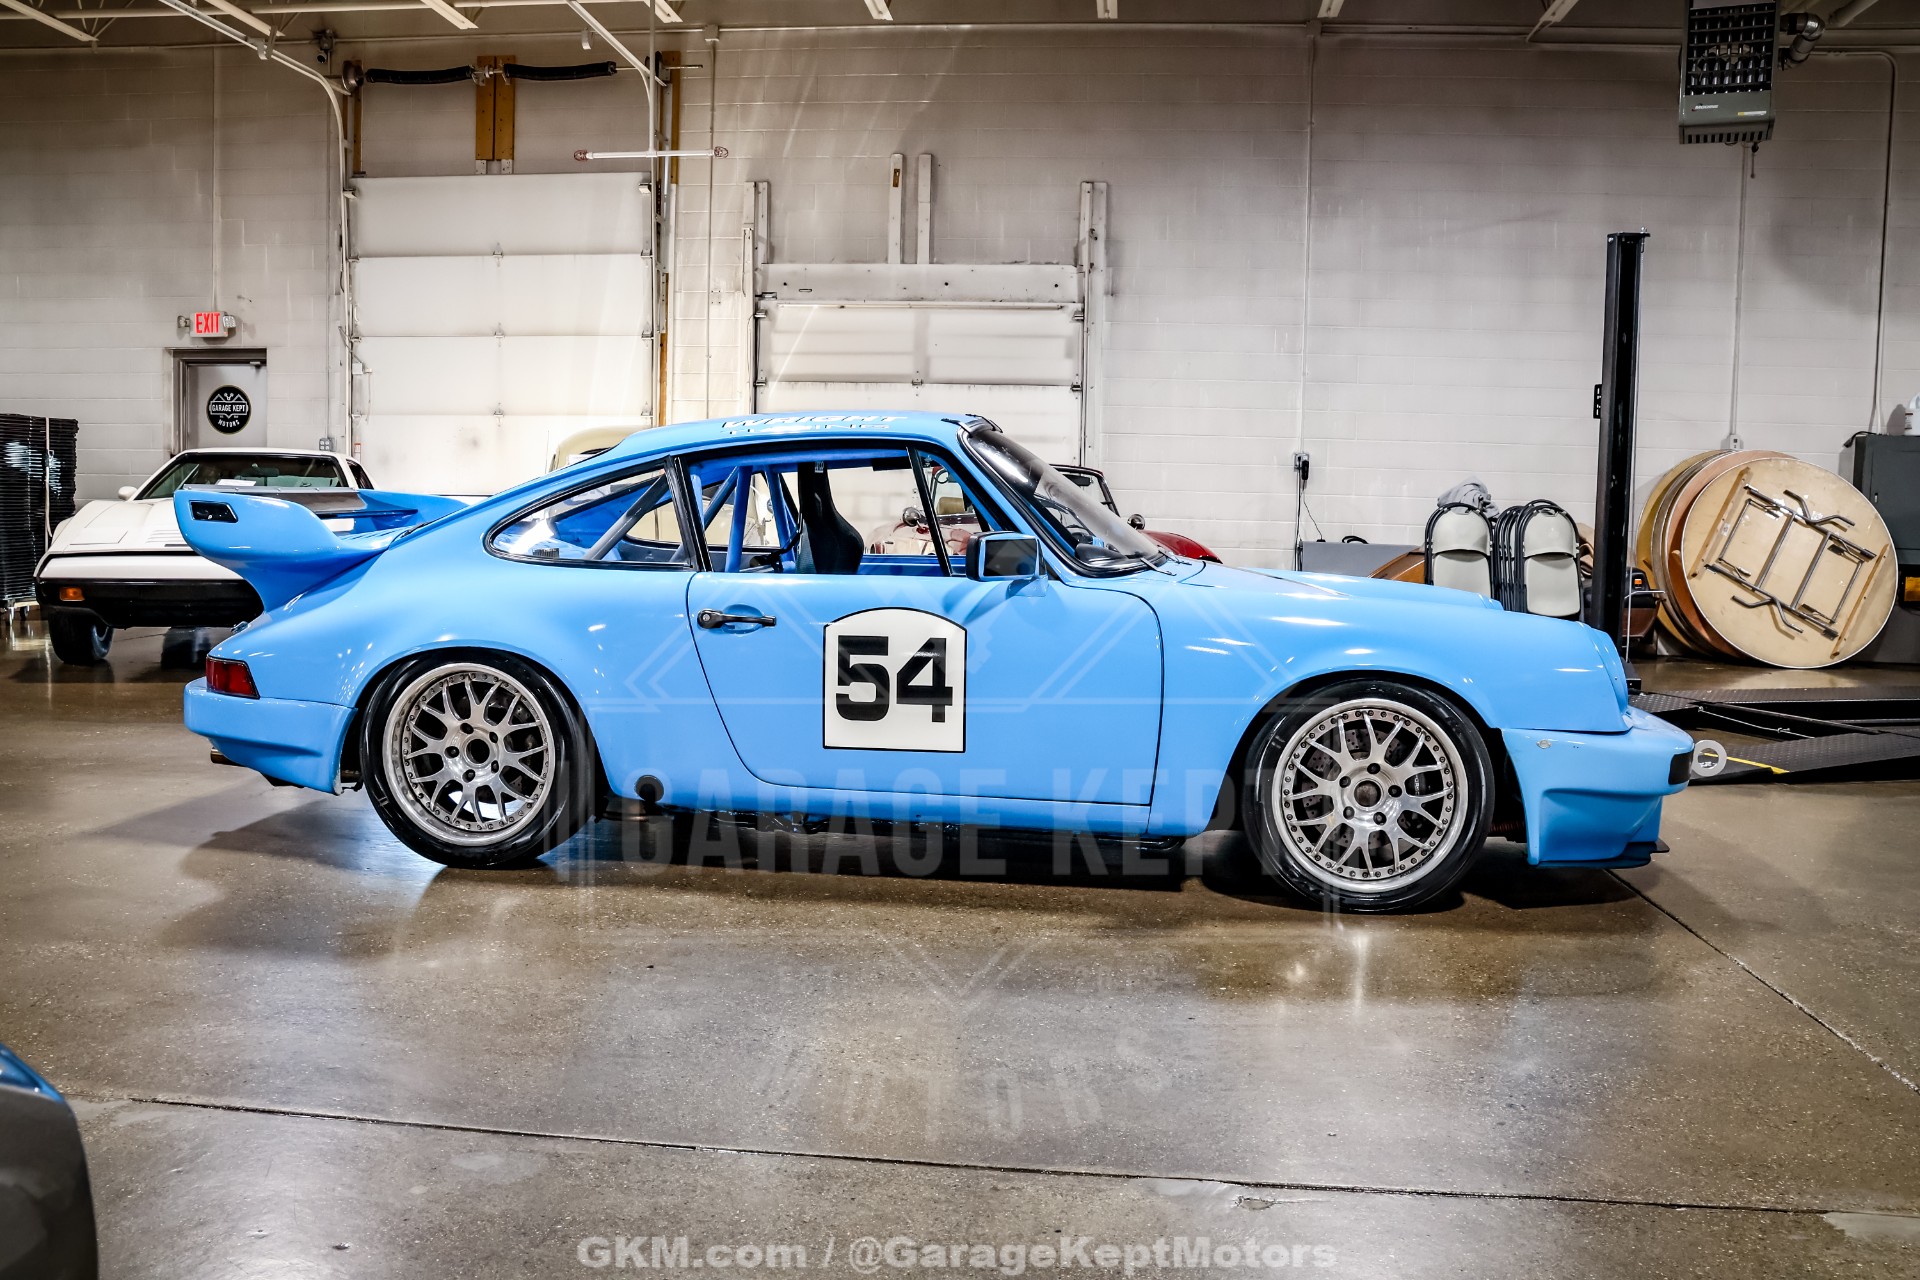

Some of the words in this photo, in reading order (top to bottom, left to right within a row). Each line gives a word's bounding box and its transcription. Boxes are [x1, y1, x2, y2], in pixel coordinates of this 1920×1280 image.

[195, 312, 220, 334] EXIT
[212, 404, 231, 412] GARAGE
[232, 404, 246, 412] KEPT
[218, 419, 240, 428] MOTORS
[721, 415, 908, 429] WRIGHT
[836, 635, 953, 723] 54
